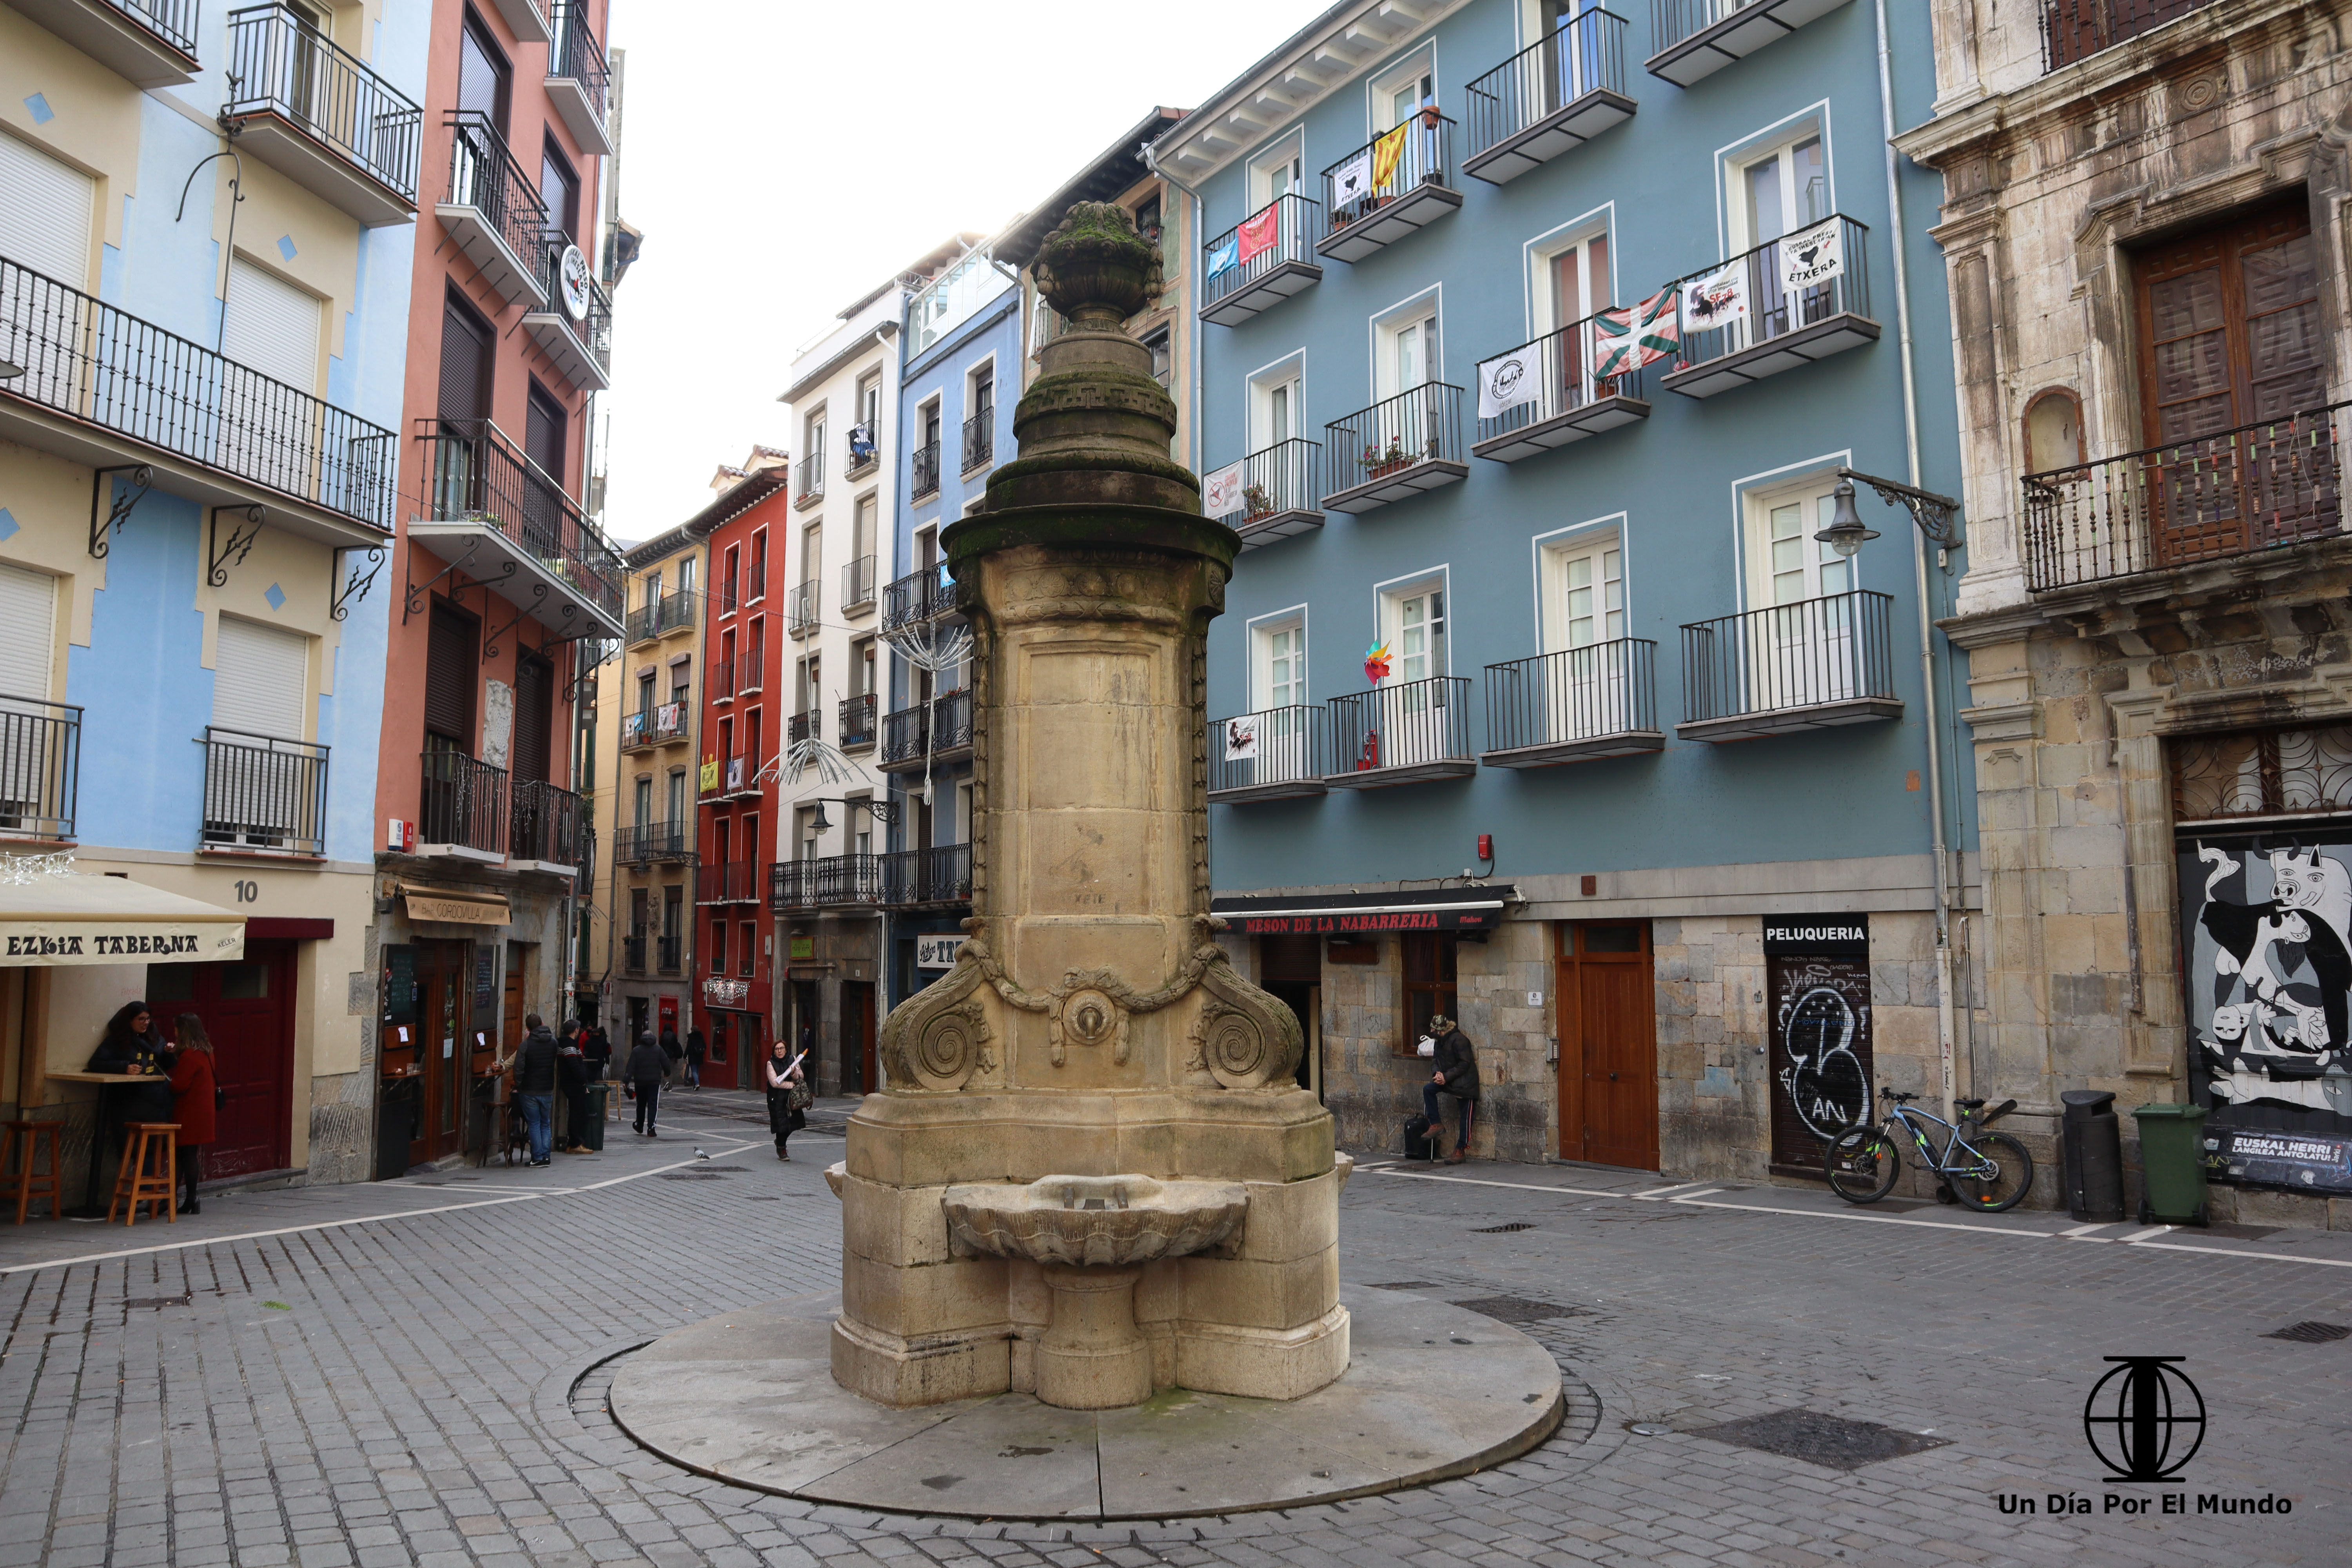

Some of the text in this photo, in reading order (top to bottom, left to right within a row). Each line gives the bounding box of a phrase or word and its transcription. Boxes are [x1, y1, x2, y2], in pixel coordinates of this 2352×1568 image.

[1341, 187, 1361, 201] ETXERA
[1789, 238, 1811, 251] EUSKAL
[580, 259, 588, 289] PRESO
[1789, 258, 1837, 282] ETXERA
[234, 880, 258, 903] 10
[437, 903, 480, 920] CORDOVILLA
[1246, 919, 1289, 932] MESON
[1294, 918, 1312, 931] DE
[1317, 917, 1334, 931] LA
[1340, 913, 1438, 931] NABARRERIA
[1767, 927, 1865, 941] PELUQUERIA
[94, 935, 199, 955] TABERNA
[217, 937, 236, 949] KELER
[2232, 1146, 2331, 1161] LANGILEA ANTOLATU!
[2234, 1137, 2331, 1154] EUSKAL HERRI
